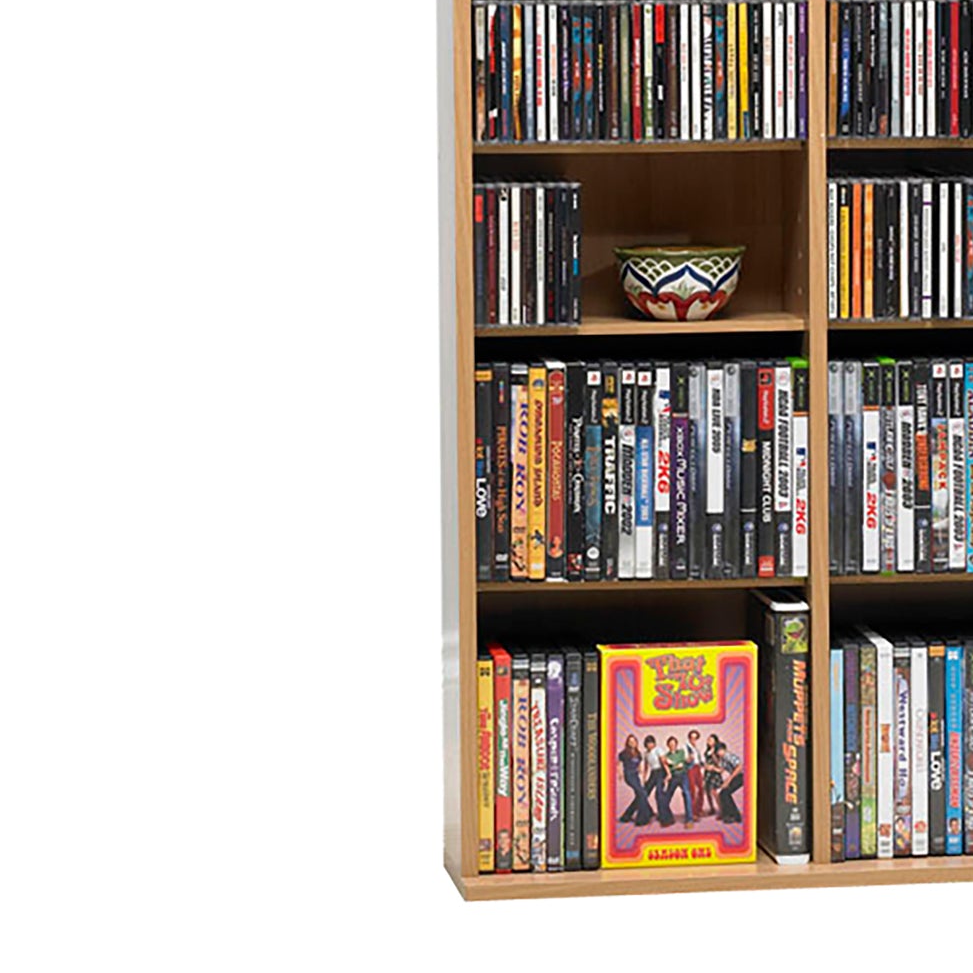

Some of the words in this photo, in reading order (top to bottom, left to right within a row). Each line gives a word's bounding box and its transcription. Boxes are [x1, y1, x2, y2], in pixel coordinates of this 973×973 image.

[604, 435, 617, 515] TRAFFIC
[658, 449, 670, 494] 2K6
[762, 494, 772, 523] CLUB
[796, 498, 806, 535] 2K6
